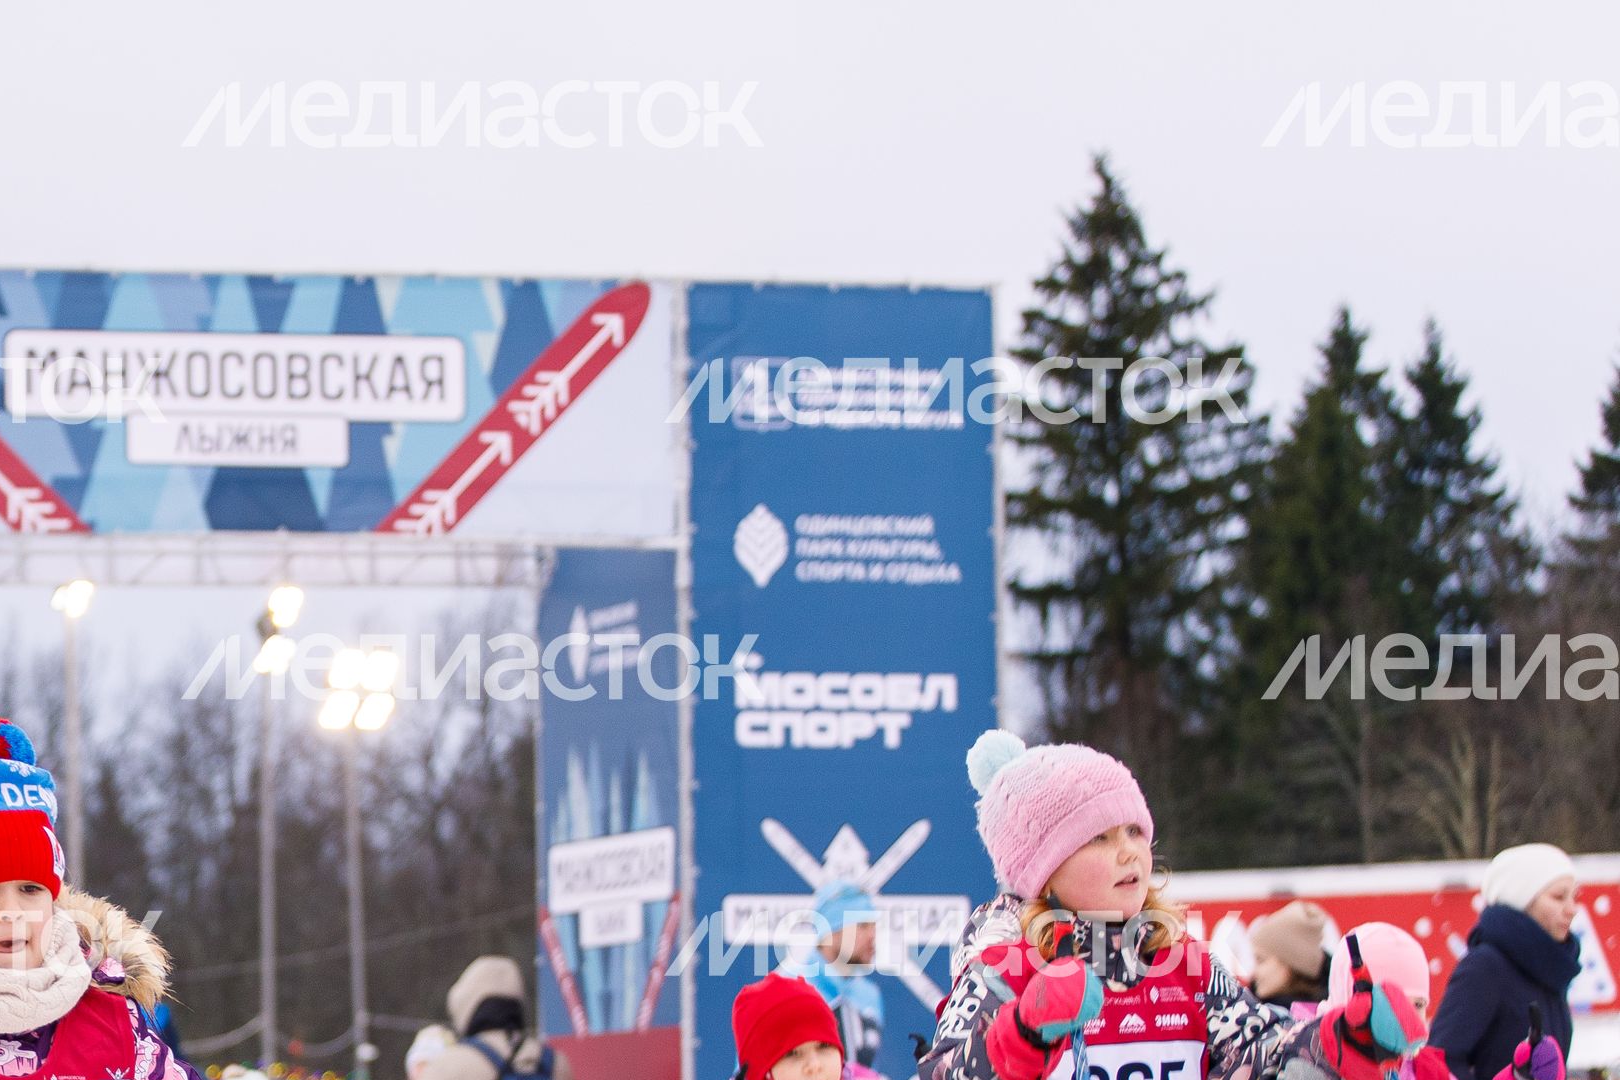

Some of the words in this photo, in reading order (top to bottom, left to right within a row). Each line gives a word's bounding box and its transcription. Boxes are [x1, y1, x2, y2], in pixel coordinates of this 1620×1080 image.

[24, 349, 446, 404] МАНЖОСОВСКАЯ
[176, 419, 300, 455] ЛЫЖНЯ
[735, 671, 958, 712] МОСОБЛ
[735, 711, 912, 749] СПОРТ
